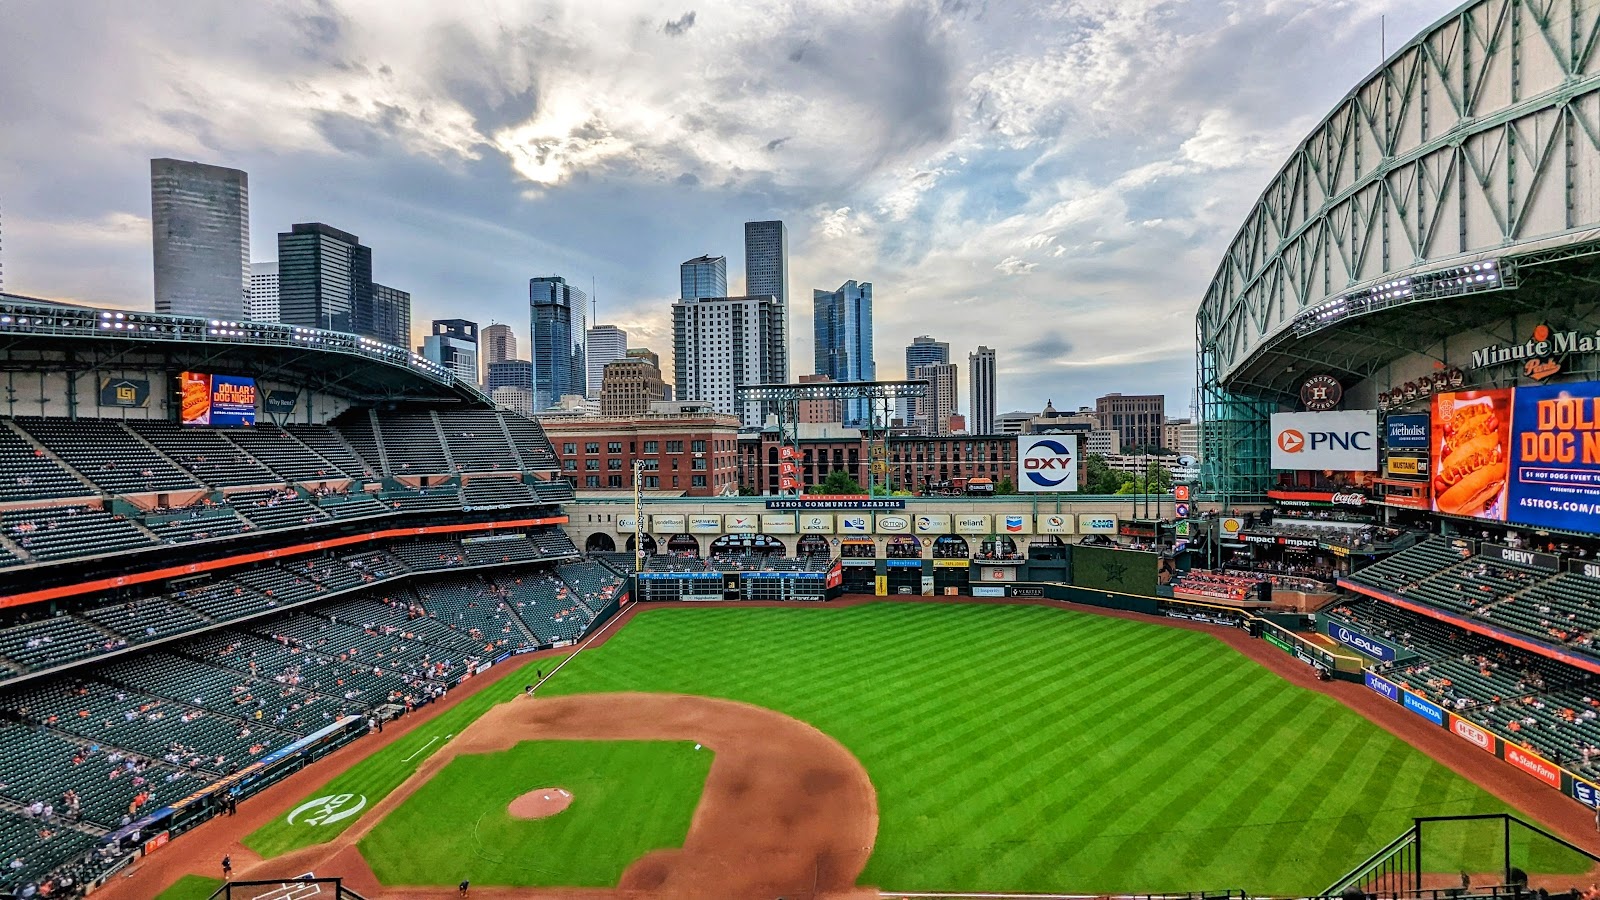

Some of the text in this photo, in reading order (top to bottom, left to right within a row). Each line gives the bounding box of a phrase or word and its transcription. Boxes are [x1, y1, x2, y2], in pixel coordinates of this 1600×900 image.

[1471, 339, 1548, 370] Minute
[1524, 359, 1560, 381] Park
[1306, 376, 1337, 388] HOUSTON
[213, 392, 255, 404] DOG NIGHT
[1312, 386, 1327, 400] H
[268, 398, 280, 407] Why
[1306, 399, 1336, 410] ASTROS
[1390, 425, 1425, 436] Methodist
[1308, 431, 1371, 450] PNC
[1520, 431, 1575, 464] DOG
[1024, 457, 1072, 471] OXY
[1392, 462, 1415, 470] MUSTANG
[1418, 462, 1427, 470] CAT
[1535, 471, 1549, 479] HOT
[1550, 472, 1569, 480] DOGS
[1570, 473, 1592, 481] EVERY
[852, 517, 865, 526] slb
[959, 518, 984, 526] reliant
[1092, 519, 1114, 528] LNG
[1245, 535, 1275, 543] impact
[1285, 538, 1317, 547] impact
[1502, 548, 1535, 564] CHEVY
[1349, 635, 1383, 656] LEXUS
[1370, 676, 1392, 695] xfinity
[1411, 699, 1441, 719] HONDA
